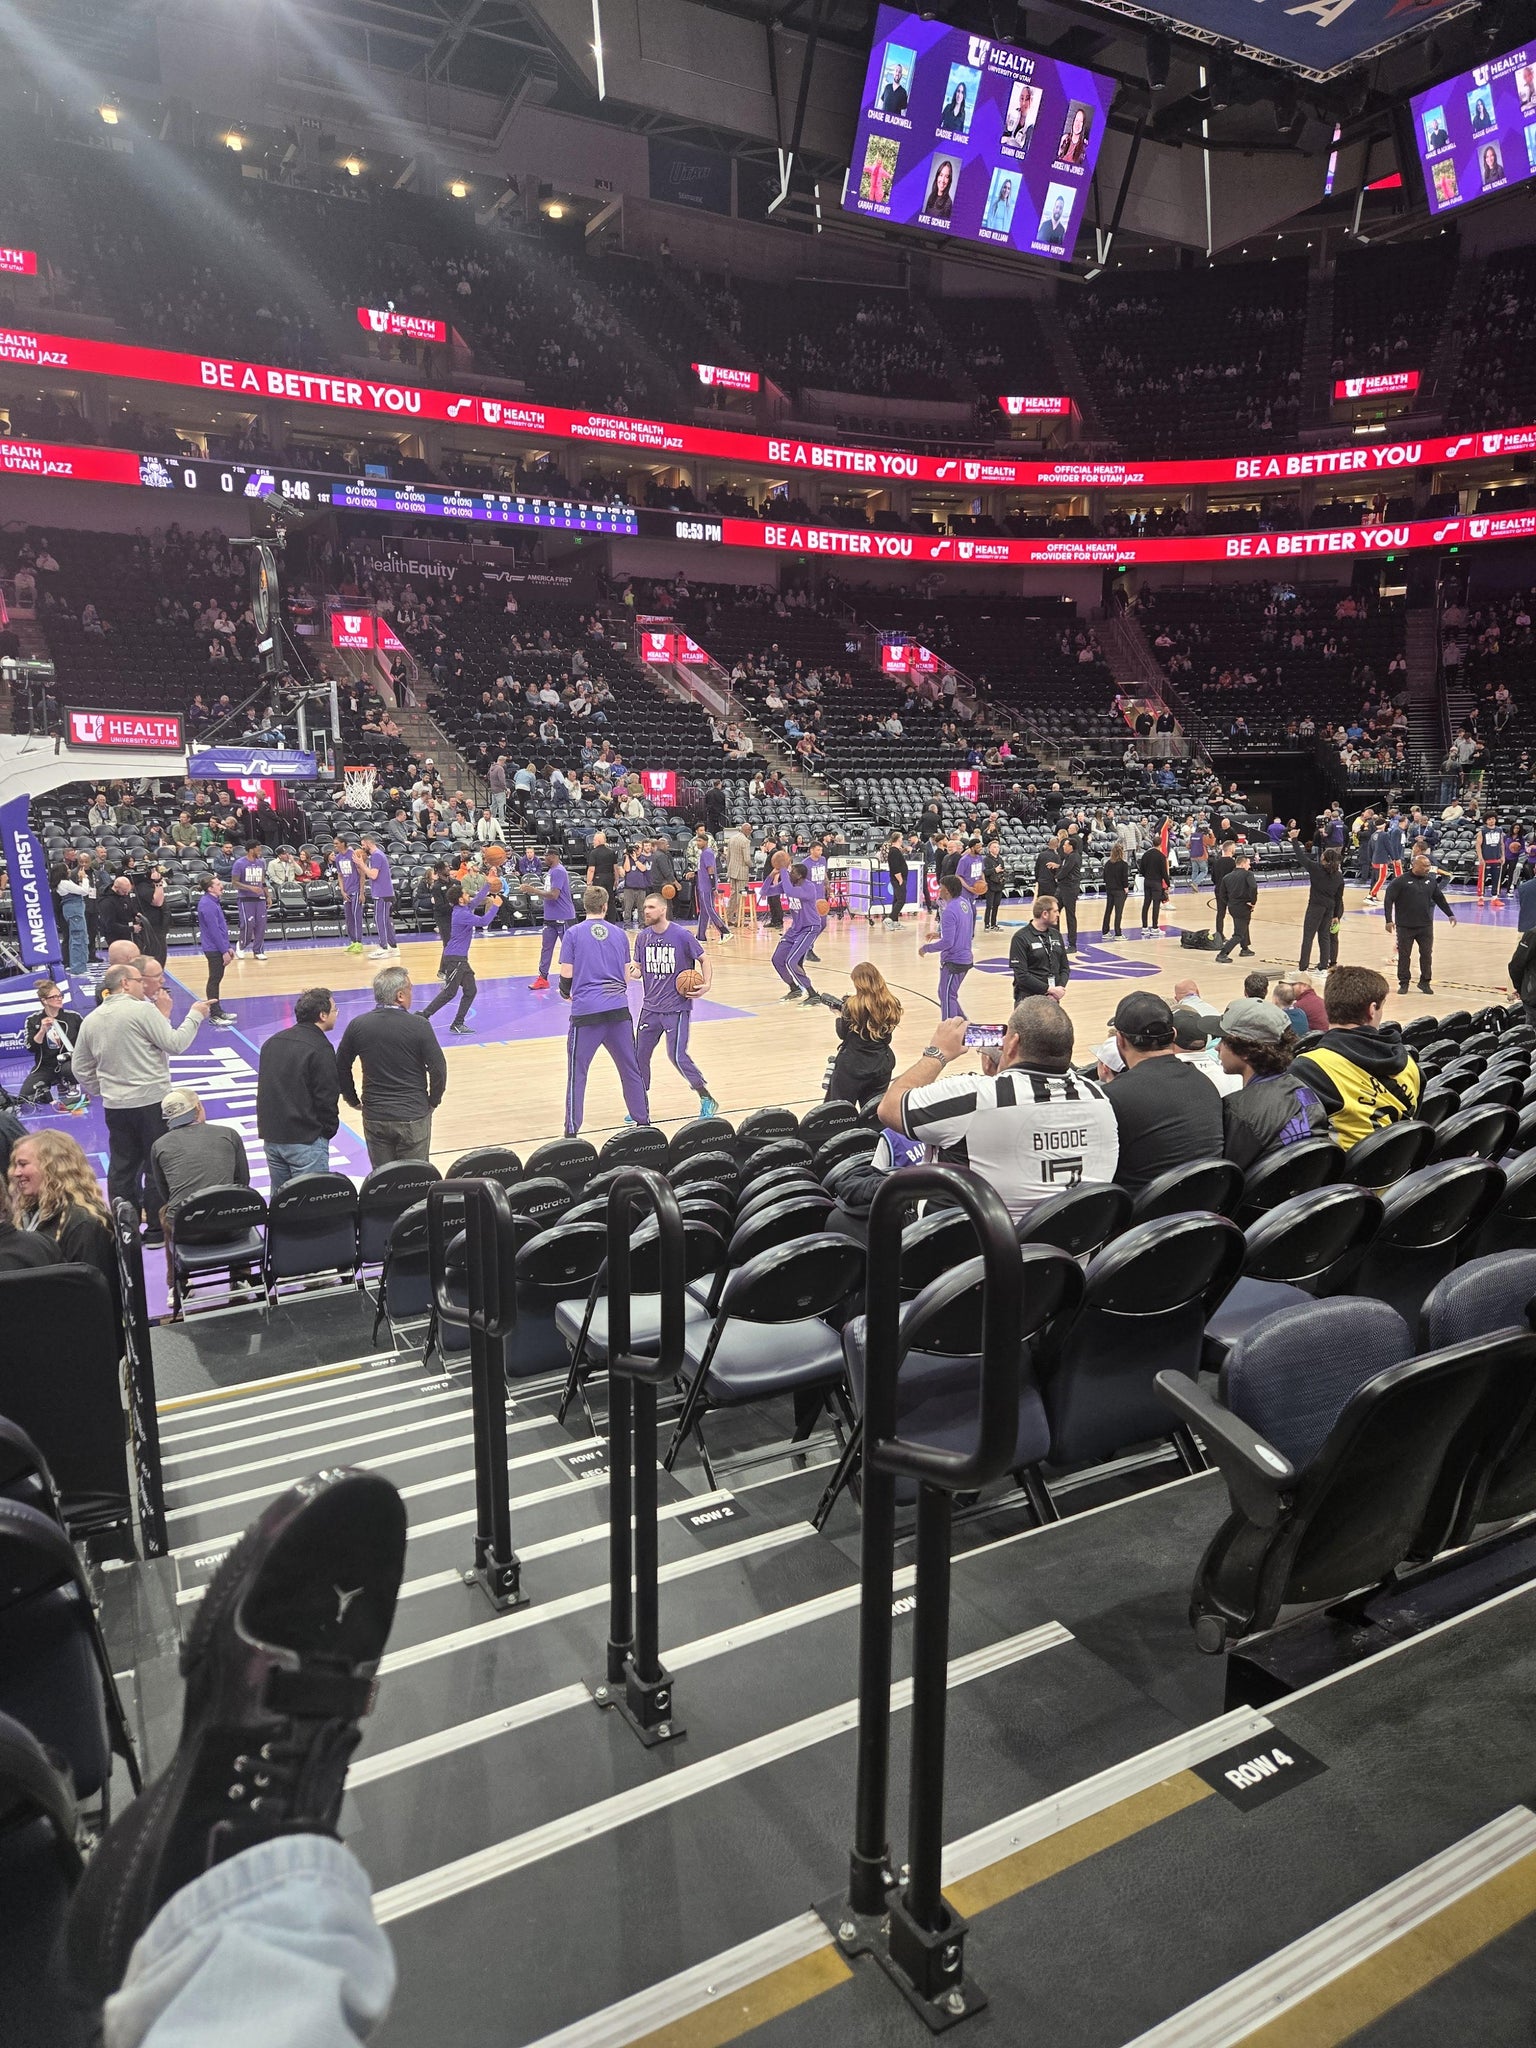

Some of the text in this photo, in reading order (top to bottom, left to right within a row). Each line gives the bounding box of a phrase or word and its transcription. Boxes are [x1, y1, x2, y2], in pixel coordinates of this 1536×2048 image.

[990, 48, 1035, 75] HEALTH
[1490, 51, 1527, 75] HEALTH
[988, 65, 1032, 83] UNIVERSITY UTAH
[867, 109, 912, 130] CHASE BLACKWELL
[918, 214, 951, 230] KATE SCHULTE
[391, 314, 436, 333] HEALTH
[37, 350, 69, 365] JAZZ
[716, 368, 751, 383] HEALTH
[1366, 374, 1409, 388] HEALTH
[200, 361, 422, 413] BE A BETTER YOU
[1025, 397, 1061, 408] HEALTH
[503, 408, 545, 424] HEALTH
[503, 419, 545, 430] UNIVERSITY UTAH
[588, 416, 664, 436] OFFICIAL HEALTH
[571, 424, 684, 449] PROVIDER FOR UTAH JAZZ
[768, 441, 918, 476] BE A BETTER YOU
[1236, 444, 1422, 479] BE A BETTER YOU
[5, 457, 73, 476] UTAH JAZZ
[981, 466, 1015, 477] HEALTH
[1054, 465, 1125, 474] OFFICIAL HEALTH
[184, 469, 197, 489] 0
[221, 473, 234, 493] 0
[1038, 473, 1144, 485] PROVIDER FOR UTAH JAZZ
[281, 479, 311, 501] 9:46
[346, 486, 377, 498] 0/0 (0%)
[395, 491, 425, 503] 0/0 (0%)
[317, 492, 330, 503] 1ST
[346, 496, 377, 509] 0/0 (0%)
[442, 496, 472, 508] 0/0 (0%)
[395, 501, 426, 513] 0/0 (0%)
[443, 507, 473, 518] 0/0 (0%)
[1490, 516, 1535, 531] HEALTH
[676, 522, 722, 542] 06:53 PM
[1490, 528, 1518, 536] UNIVERSITY
[765, 526, 913, 556] BE A BETTER YOU
[1047, 543, 1117, 552] OFFICIAL HEALTH
[1226, 528, 1409, 557] BE A BETTER YOU
[975, 545, 1009, 555] HEALTH
[1031, 551, 1136, 563] PROVIDER FOR UTAH JAZZ
[527, 574, 573, 584] AMERICA FIRST
[339, 635, 368, 643] HEALTH
[109, 720, 177, 738] HEALTH
[110, 736, 149, 744] UNIVERSITY
[14, 830, 49, 954] AMERICA FIRST
[645, 946, 676, 963] BLACK
[829, 1116, 857, 1126] entrata
[765, 1126, 795, 1134] entrata
[700, 1133, 733, 1145] entrata
[1033, 1129, 1088, 1151] BIGODE
[634, 1143, 666, 1153] entrata
[560, 1155, 595, 1166] entrata
[482, 1165, 519, 1176] entrata
[398, 1179, 437, 1190] entrata
[309, 1189, 350, 1203] entrata
[217, 1203, 261, 1217] entrata
[529, 1197, 571, 1214] entrata
[371, 1359, 389, 1367] ROW
[421, 1383, 441, 1393] ROW
[569, 1450, 604, 1465] ROW 1
[580, 1467, 604, 1479] SEC
[690, 1506, 735, 1527] ROW 2
[1223, 1747, 1296, 1791] ROW 4
